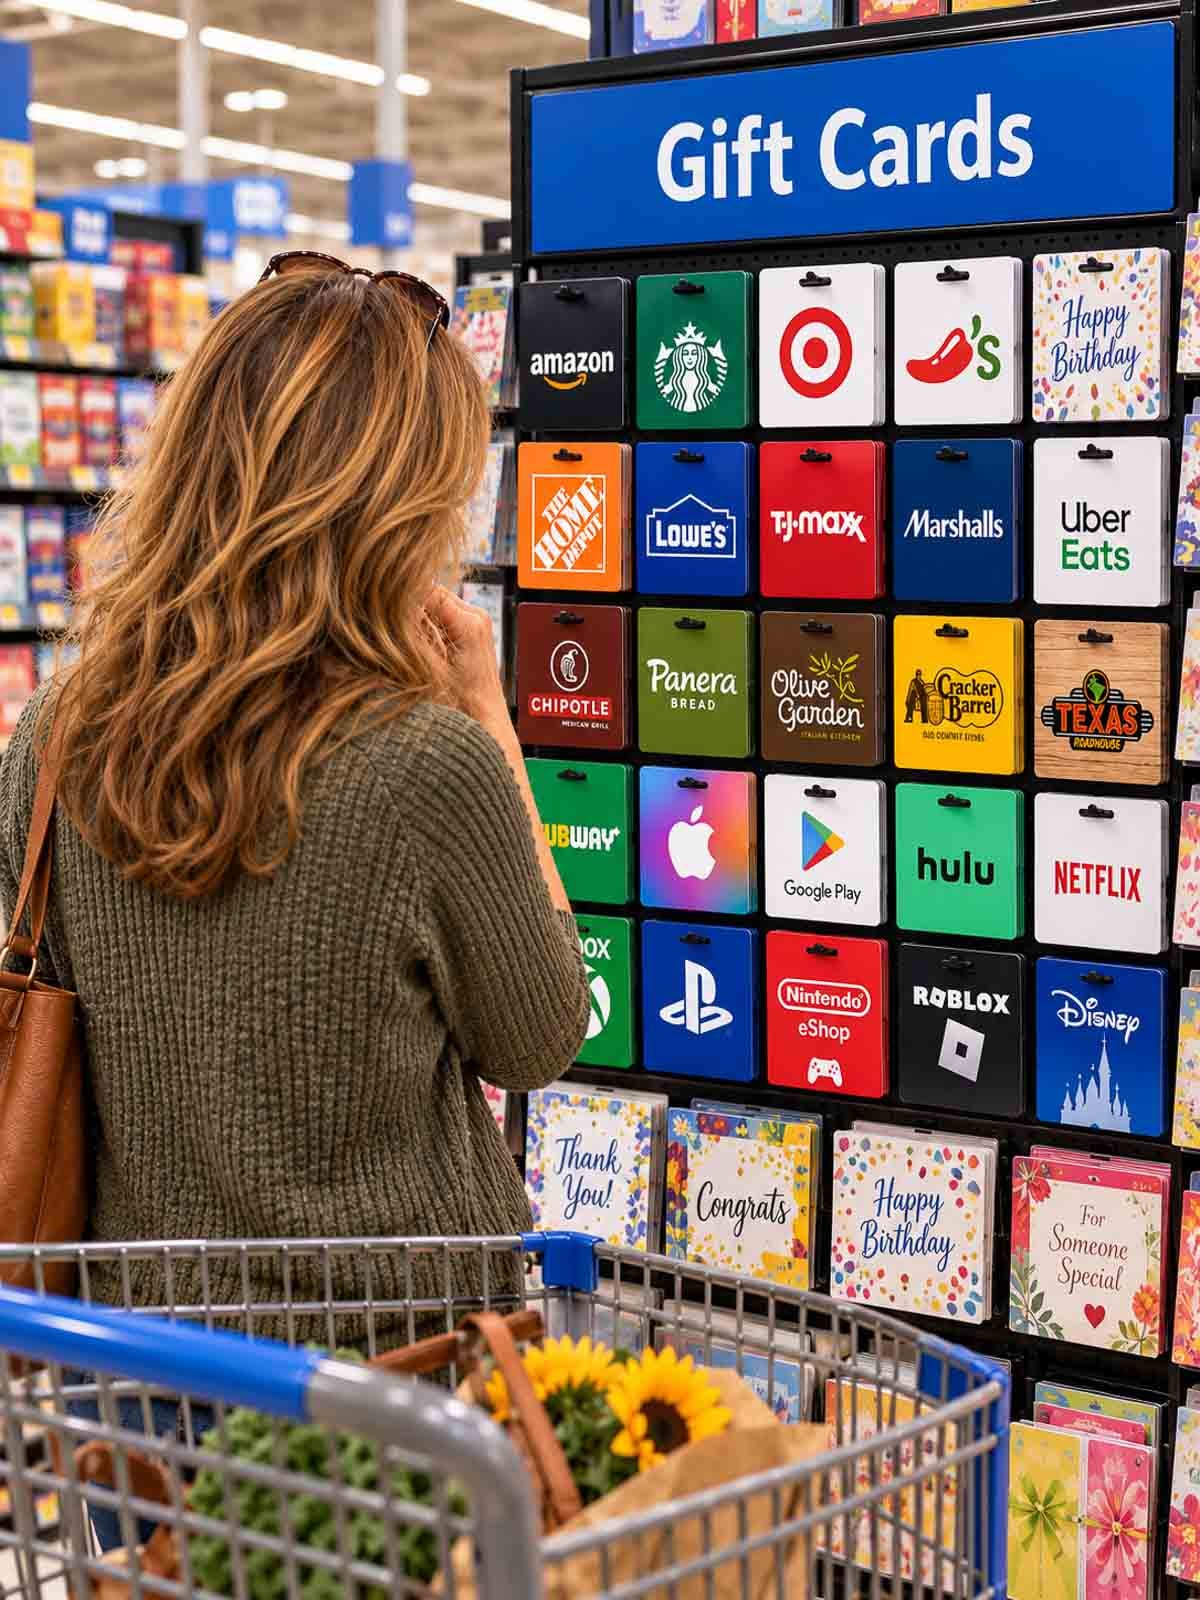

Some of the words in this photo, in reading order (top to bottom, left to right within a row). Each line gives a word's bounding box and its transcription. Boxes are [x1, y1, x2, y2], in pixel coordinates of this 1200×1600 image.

[657, 113, 794, 203] Gift
[819, 93, 1034, 191] Cards
[1062, 294, 1130, 340] Happy
[530, 348, 615, 377] amazon
[1051, 331, 1141, 383] Birthday
[542, 487, 570, 523] THE
[1061, 501, 1131, 534] Uber
[535, 476, 605, 569] HOME
[655, 521, 727, 549] LOWE'S
[903, 509, 1004, 539] Marshalls
[561, 512, 604, 570] DEPOT
[1061, 538, 1131, 571] Eats
[646, 658, 738, 695] Panera
[770, 668, 831, 698] Olive
[938, 672, 997, 699] Cracker
[530, 696, 609, 716] CHIPOTLE
[671, 697, 716, 711] BREAD
[778, 696, 865, 732] Garden
[946, 695, 996, 722] Barrel
[1055, 702, 1139, 735] TEXAS
[543, 823, 621, 852] UBWAY
[917, 847, 995, 885] hulu
[1054, 860, 1142, 903] NETFLIX
[784, 879, 832, 902] Google
[834, 882, 862, 905] Play
[786, 986, 862, 1011] Nintendo
[913, 985, 1011, 1016] ROBLOX
[798, 1018, 851, 1044] eShop
[555, 1134, 622, 1175] Thank
[562, 1173, 614, 1220] You!
[696, 1180, 791, 1237] Congrats
[873, 1176, 945, 1226] Happy
[1079, 1203, 1107, 1229] For
[860, 1219, 956, 1272] Birthday
[1048, 1222, 1129, 1261] Someone
[1056, 1259, 1125, 1295] Special
